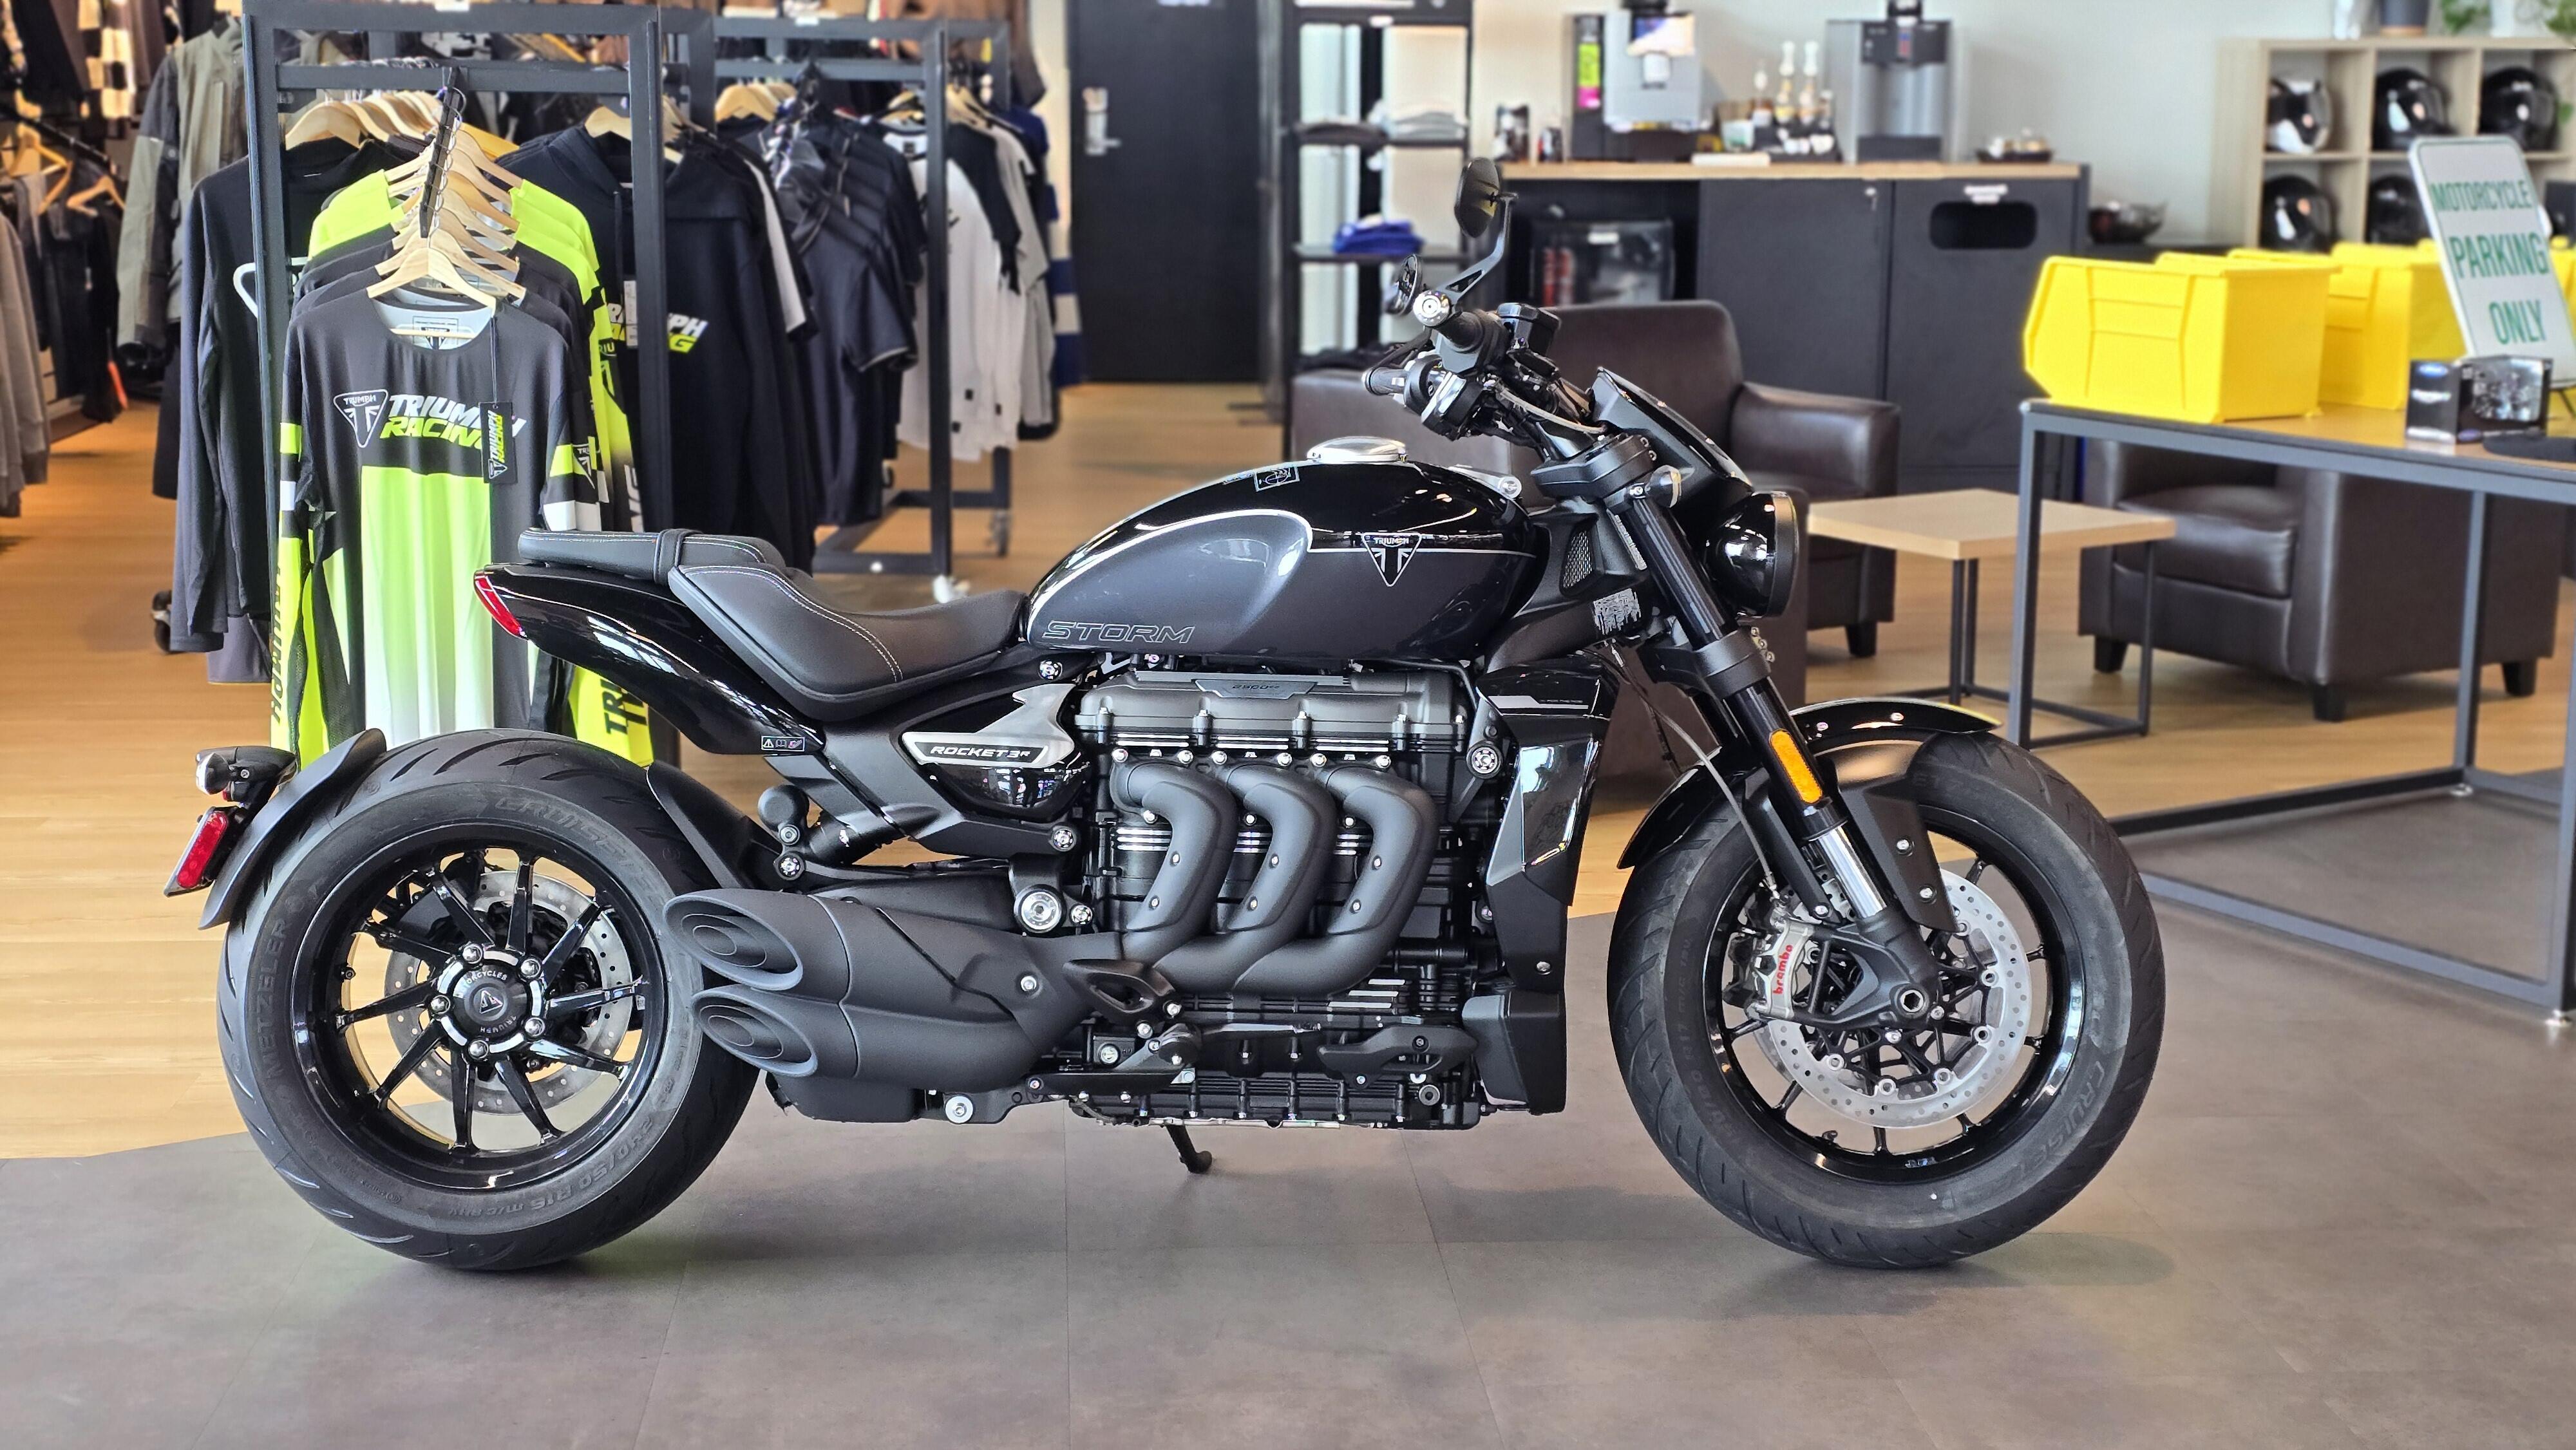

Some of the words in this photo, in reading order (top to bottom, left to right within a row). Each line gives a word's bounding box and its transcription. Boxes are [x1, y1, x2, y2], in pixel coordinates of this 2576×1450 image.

[2431, 180, 2532, 211] MOTORCYCLE
[2449, 232, 2550, 278] PARKING
[2489, 300, 2546, 345] ONLY
[343, 394, 376, 406] TRIUMPH
[389, 394, 527, 437] TRIUM
[380, 417, 482, 449] RACIN
[1373, 537, 1409, 547] TRIUMPH
[1042, 620, 1195, 644] STORM
[1773, 945, 1793, 994] brembo
[258, 918, 287, 1079] METZELER
[480, 1015, 516, 1033] TRIUMPH
